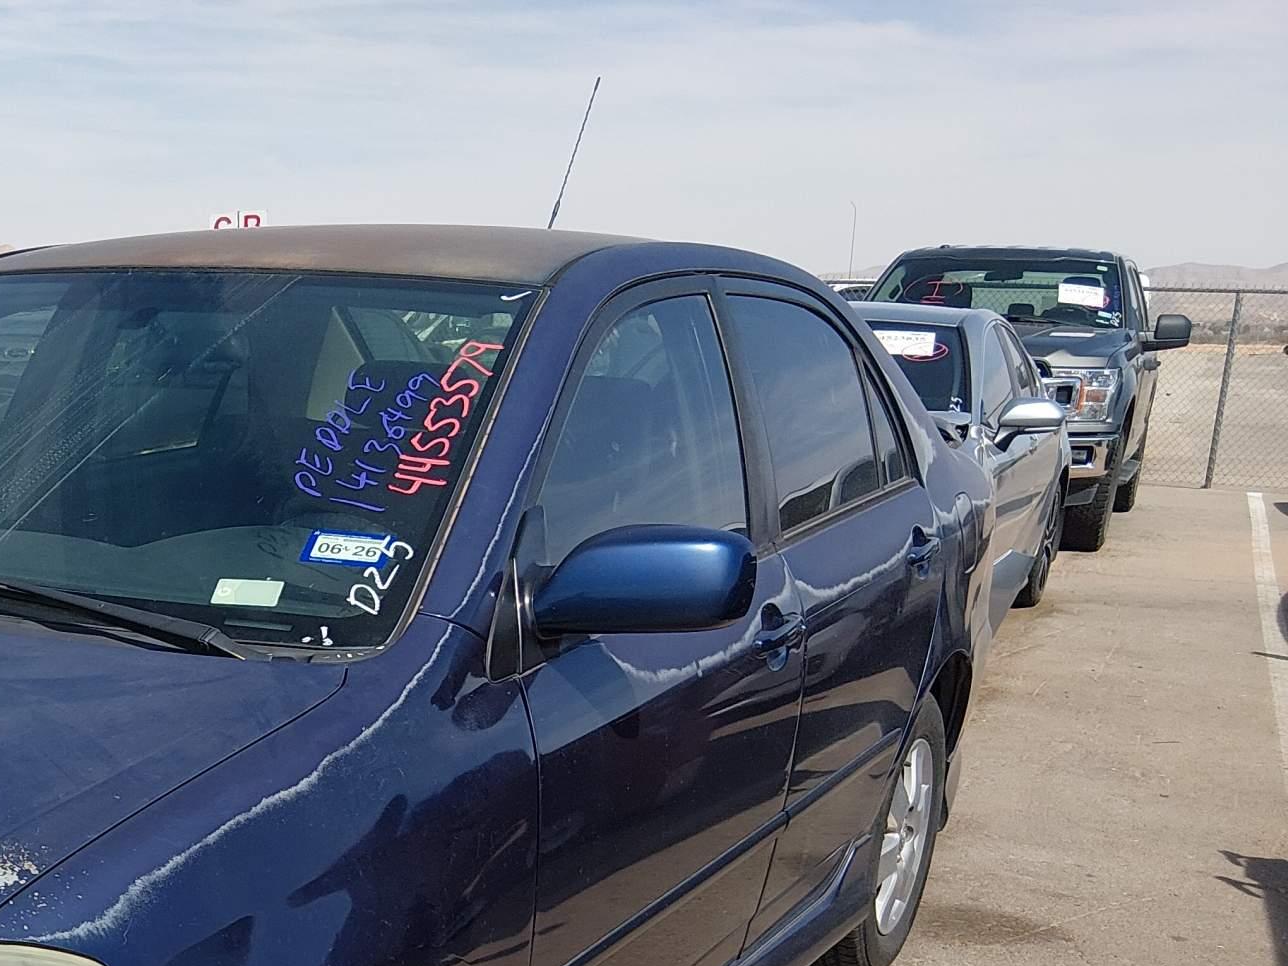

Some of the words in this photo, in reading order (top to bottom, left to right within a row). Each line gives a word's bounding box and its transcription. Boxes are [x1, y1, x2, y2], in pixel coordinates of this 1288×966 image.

[294, 367, 386, 497] PEDDLE
[387, 339, 506, 495] 44553579
[317, 542, 343, 555] 06
[351, 545, 380, 558] 26
[346, 534, 414, 615] D25
